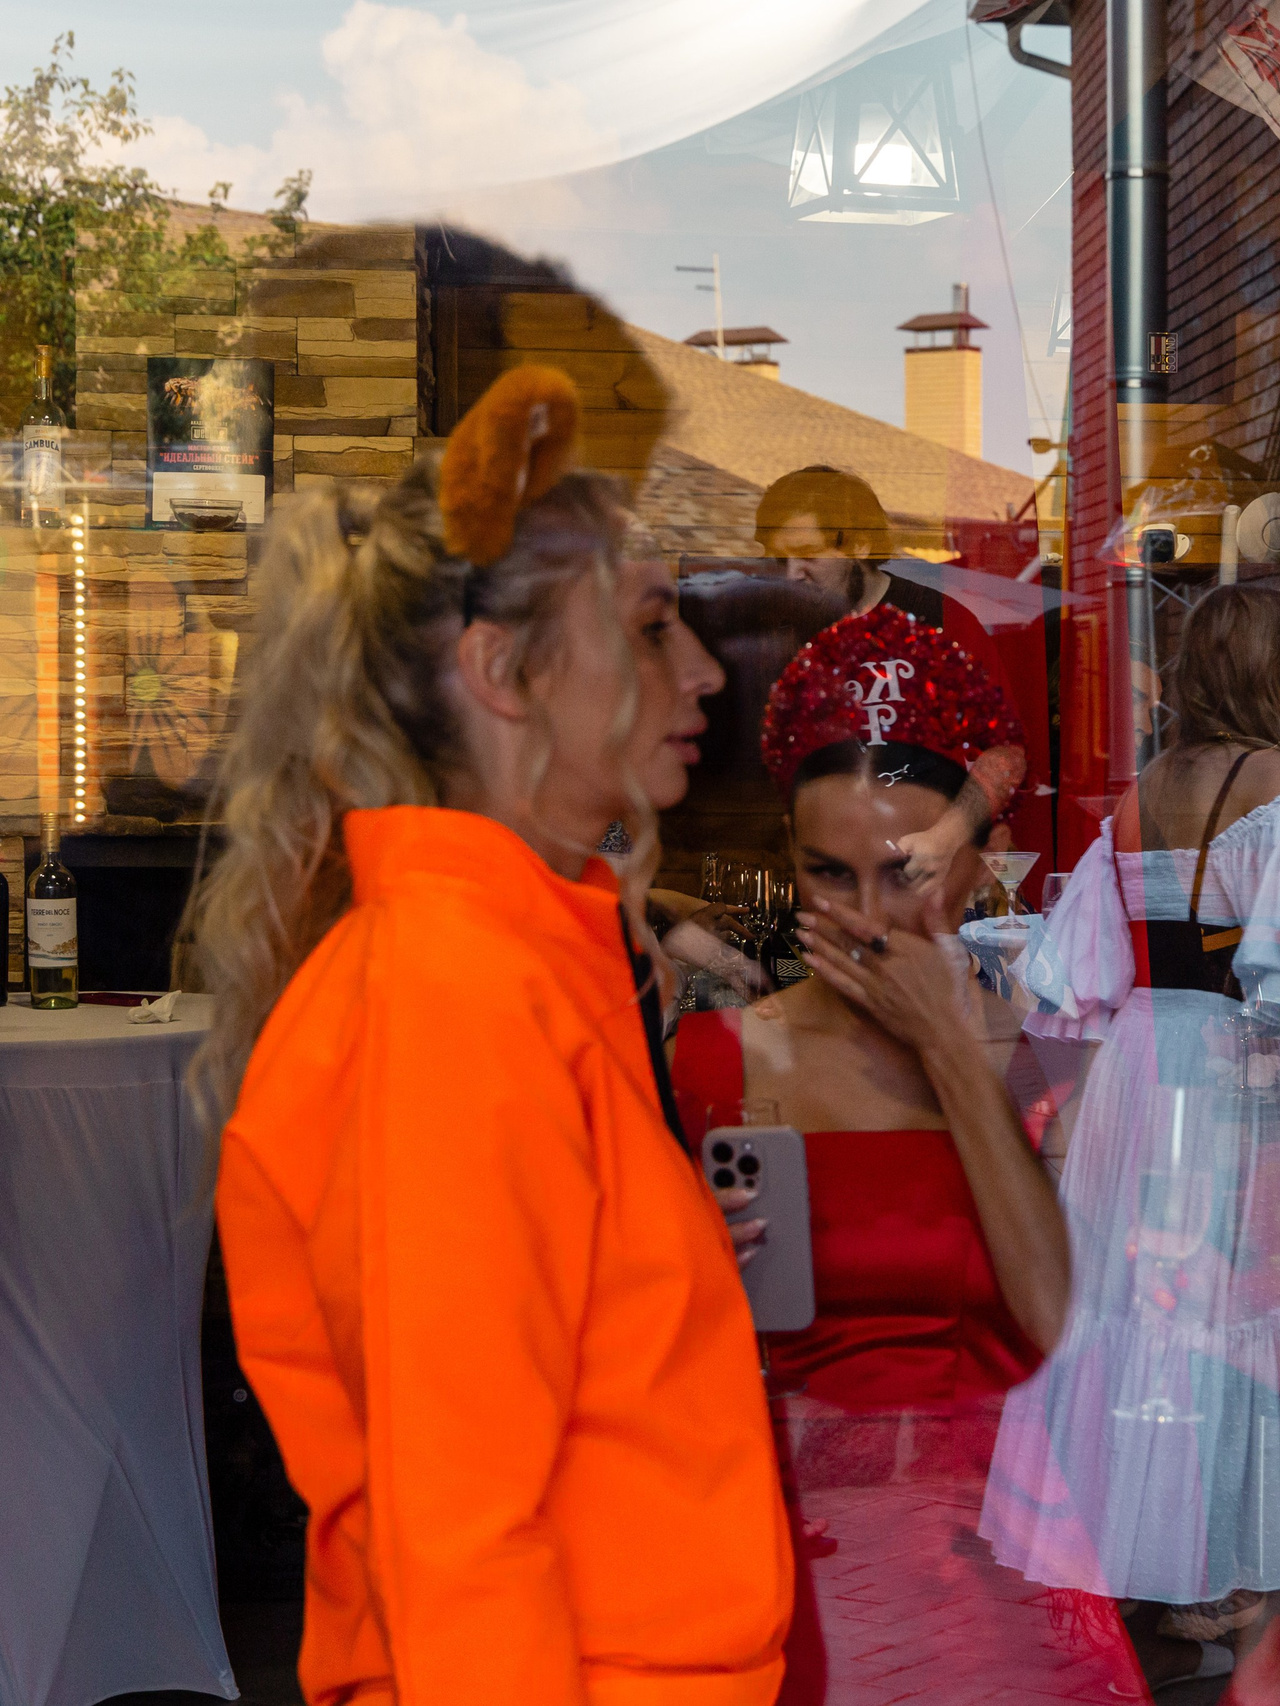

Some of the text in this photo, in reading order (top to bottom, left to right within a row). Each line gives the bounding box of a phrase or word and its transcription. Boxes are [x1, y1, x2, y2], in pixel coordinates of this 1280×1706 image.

[1166, 336, 1176, 371] SOUND
[25, 439, 60, 451] SAMBUCA
[31, 908, 45, 916] TERRE
[54, 908, 70, 916] NOCE
